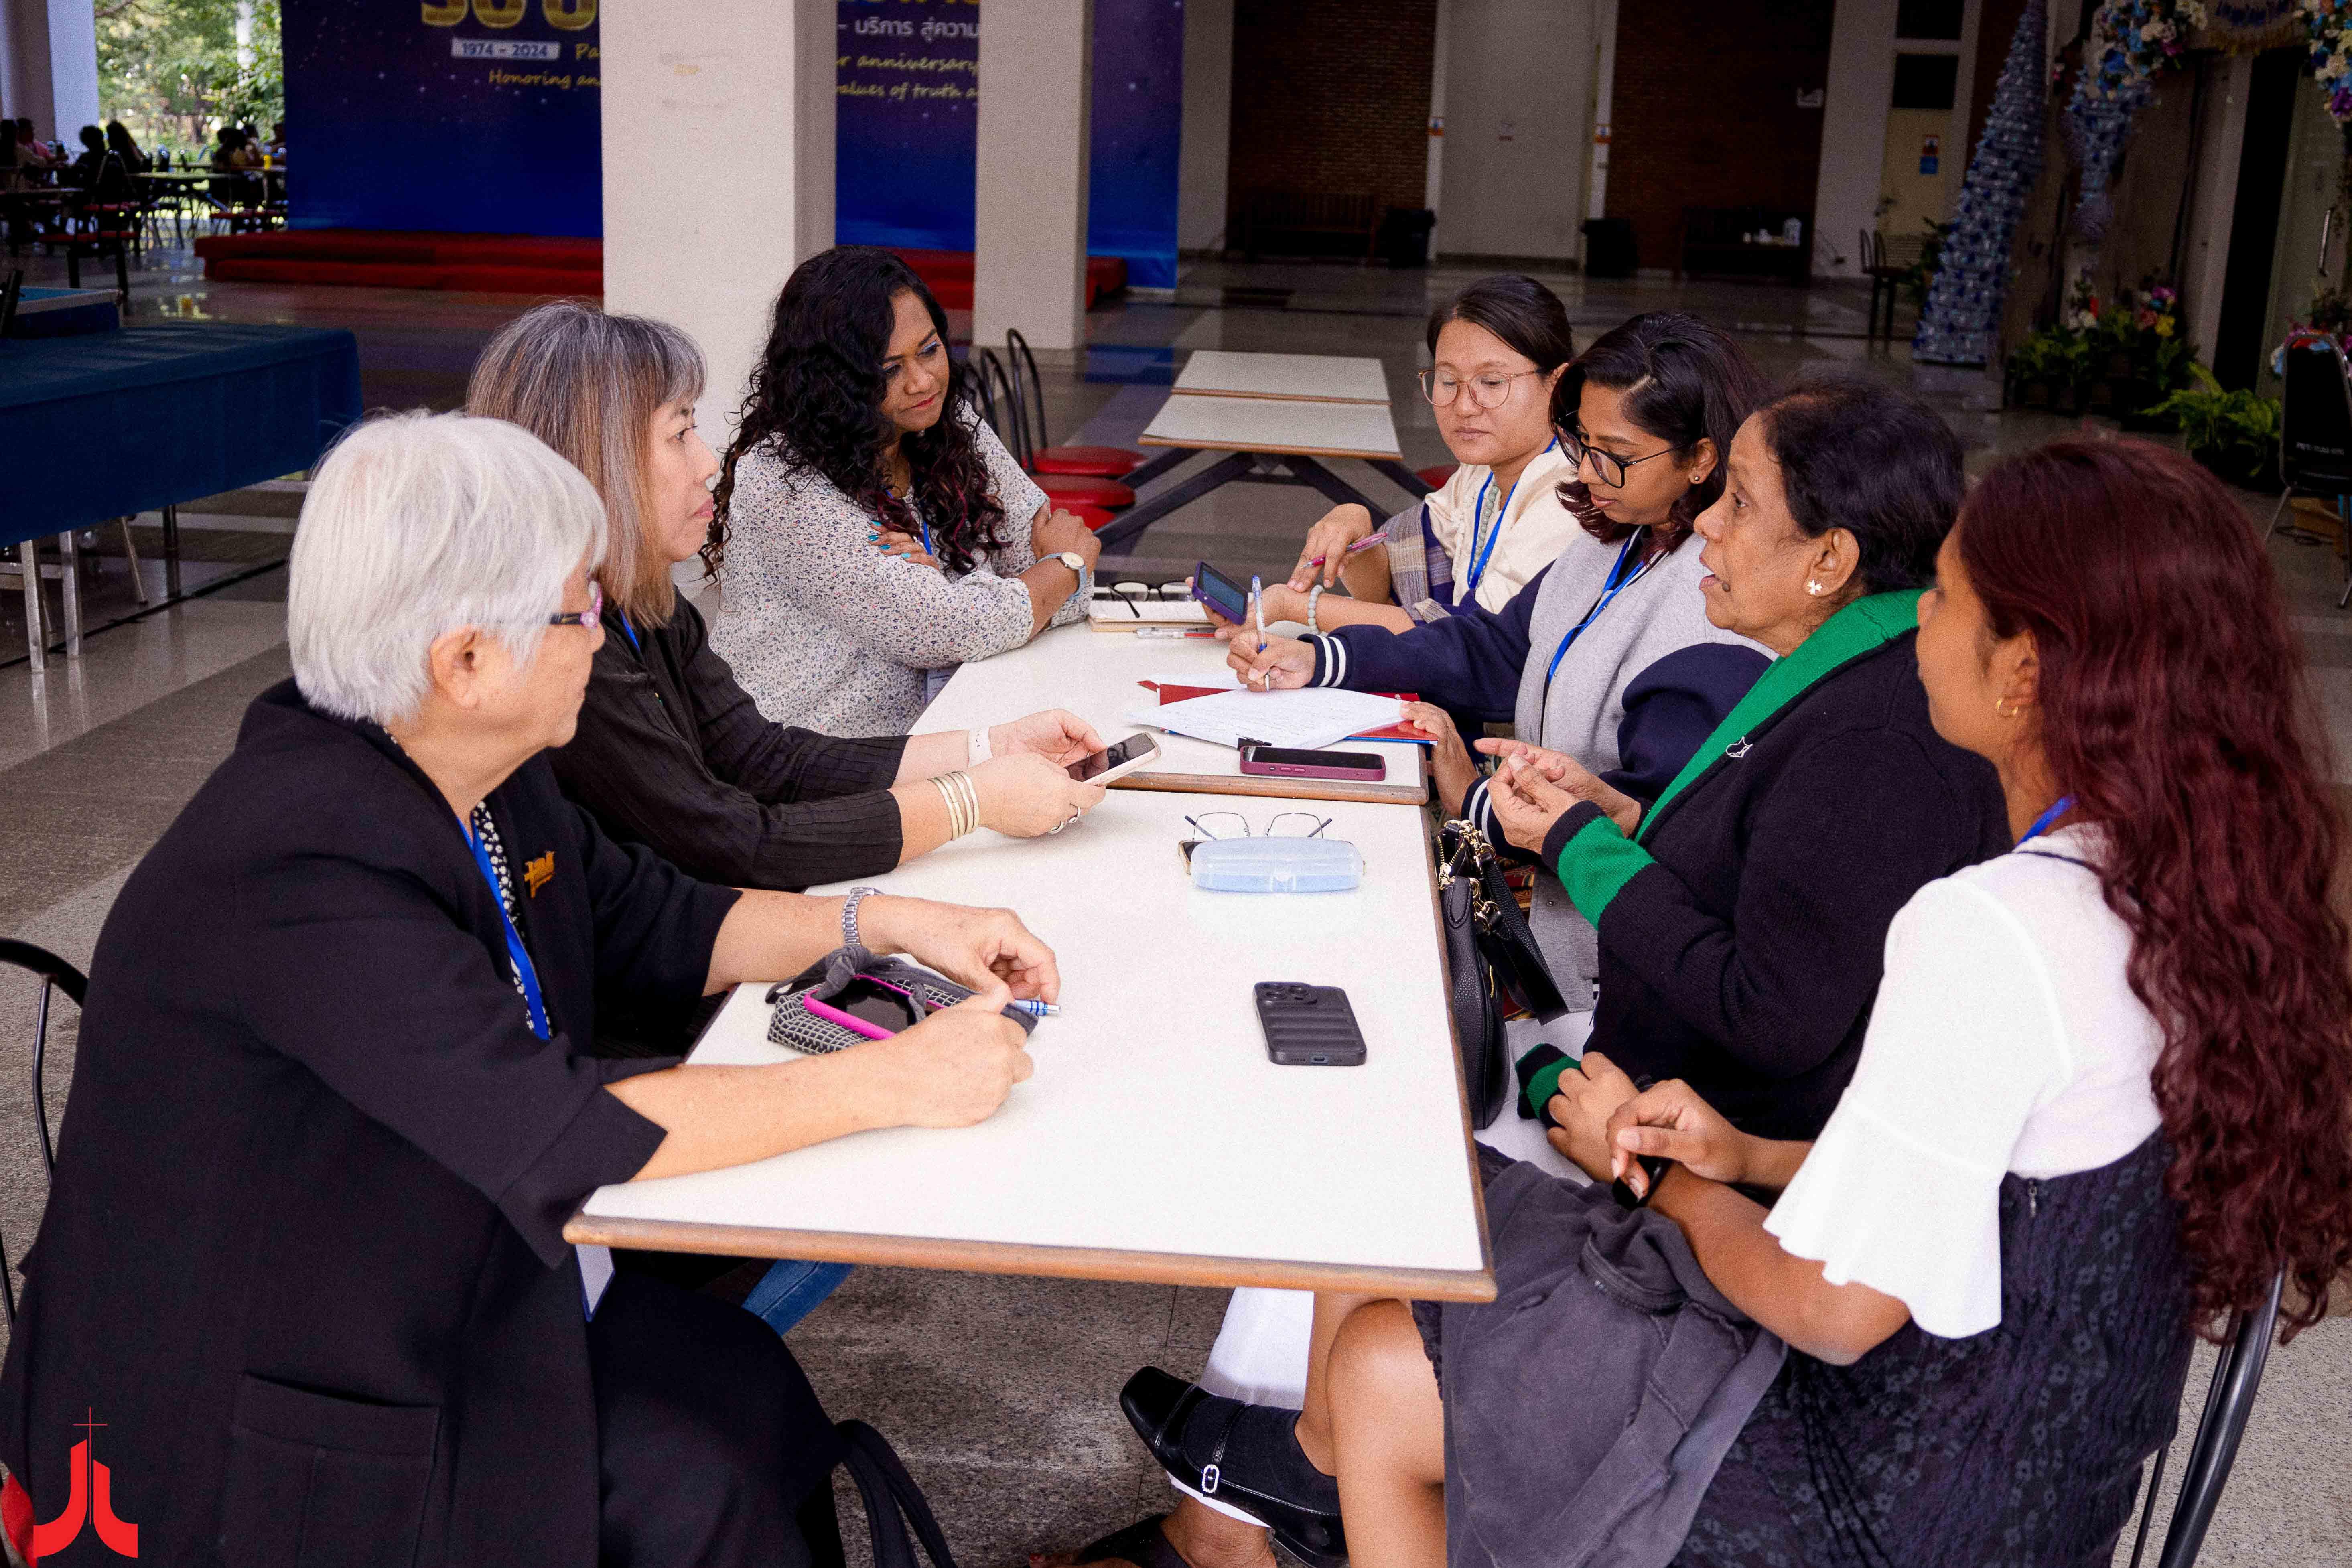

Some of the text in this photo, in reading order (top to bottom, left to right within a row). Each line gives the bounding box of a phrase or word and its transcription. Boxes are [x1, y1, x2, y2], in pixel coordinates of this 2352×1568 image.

[855, 16, 913, 36] บริการ
[463, 43, 493, 55] 1974
[512, 43, 548, 57] 2024
[489, 69, 571, 89] Honoring
[838, 80, 885, 97] alues
[889, 81, 910, 102] of
[912, 82, 962, 99] truth
